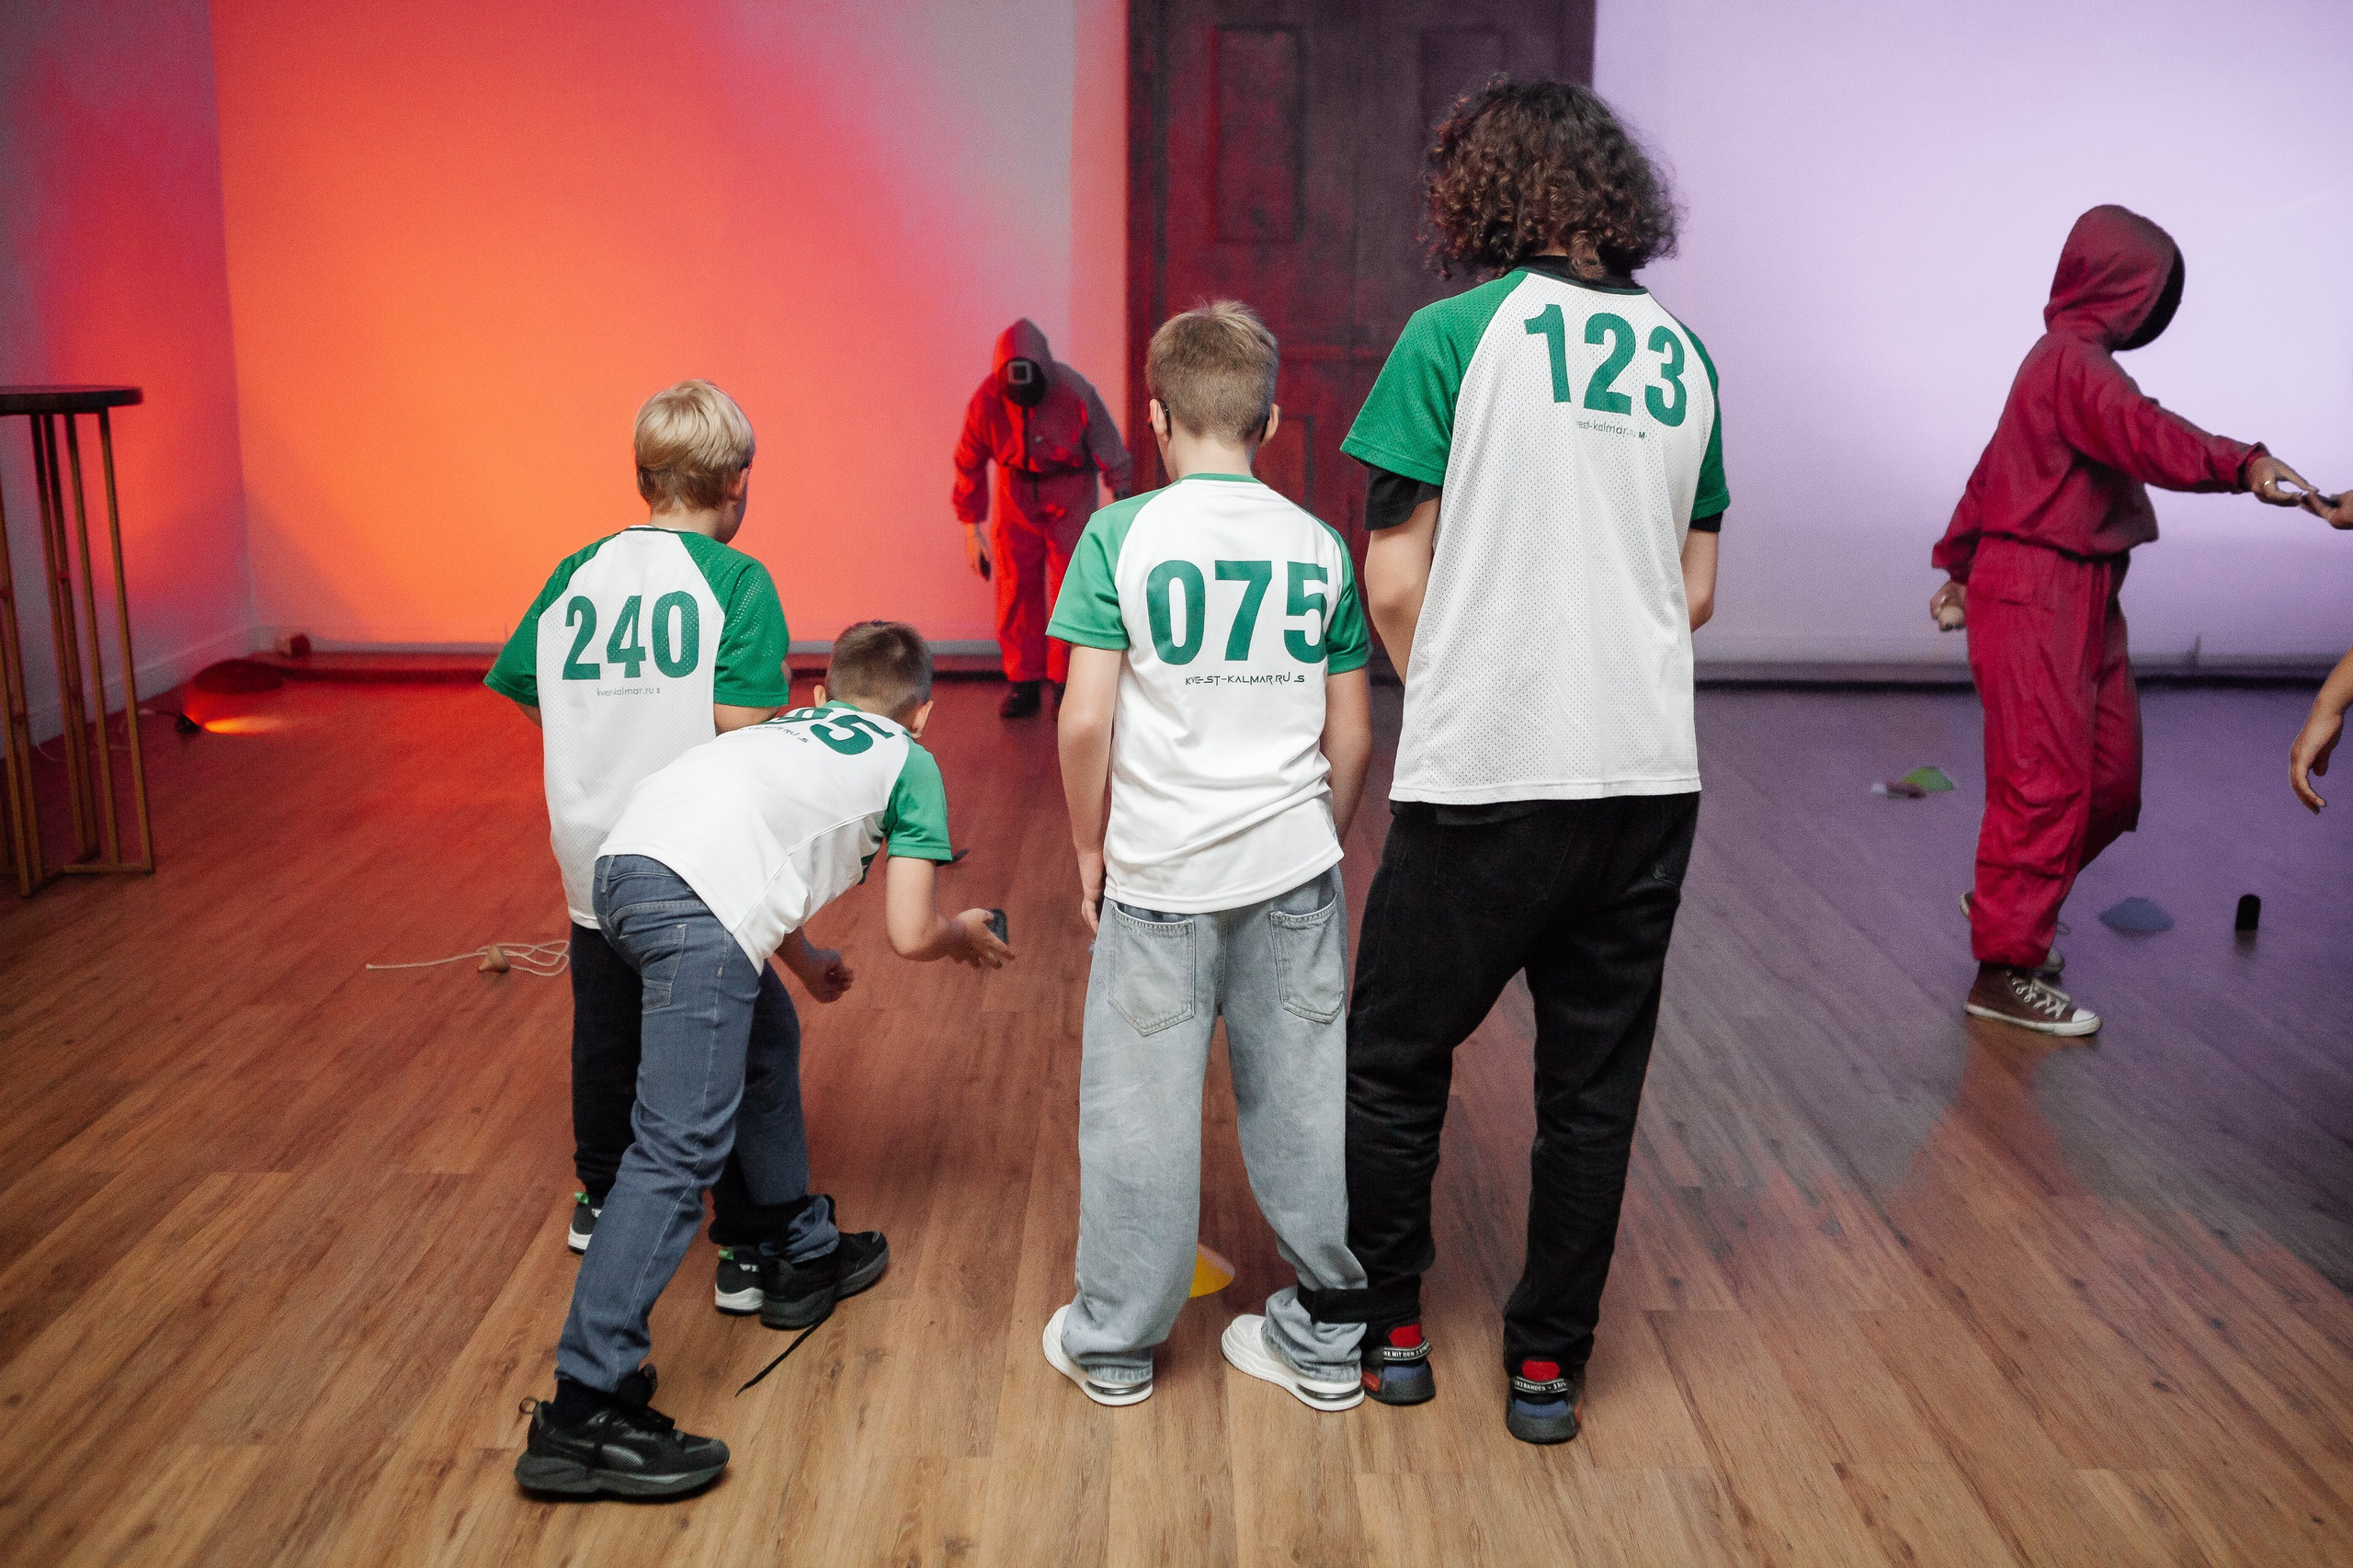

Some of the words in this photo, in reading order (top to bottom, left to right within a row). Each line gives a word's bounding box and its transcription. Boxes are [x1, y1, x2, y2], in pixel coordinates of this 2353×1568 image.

[1524, 303, 1688, 427] 123
[1638, 431, 1646, 440] M
[563, 590, 699, 680] 240
[1146, 560, 1328, 665] 075
